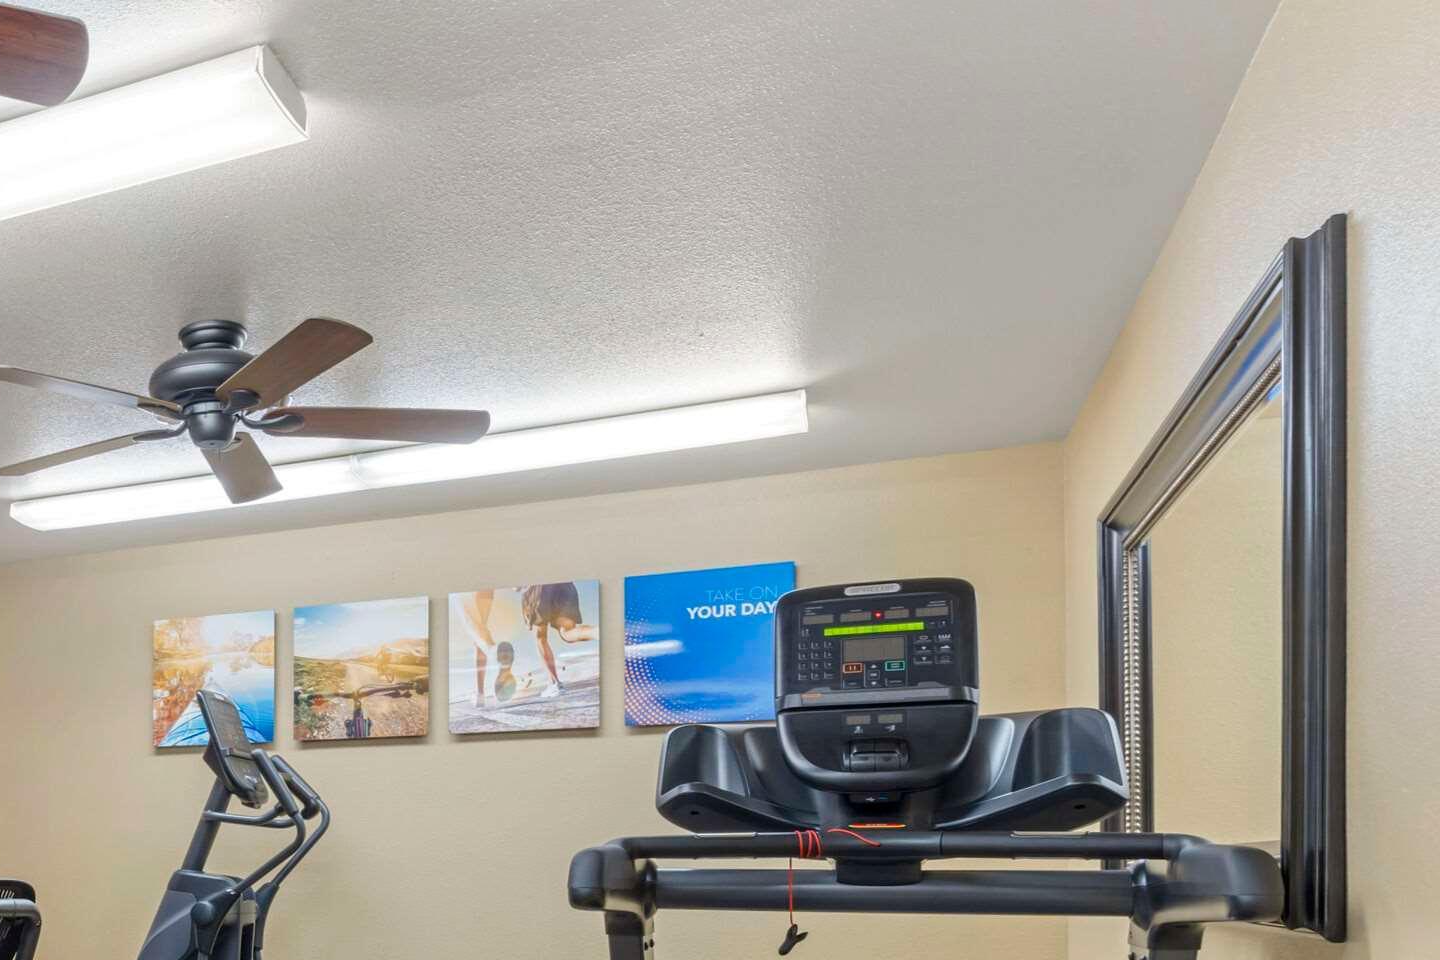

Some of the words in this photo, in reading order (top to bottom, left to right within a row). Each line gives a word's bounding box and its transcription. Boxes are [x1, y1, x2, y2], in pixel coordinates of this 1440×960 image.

[706, 587, 745, 602] TAKE
[749, 585, 778, 600] ON
[686, 604, 737, 619] YOUR
[741, 601, 776, 616] DAY
